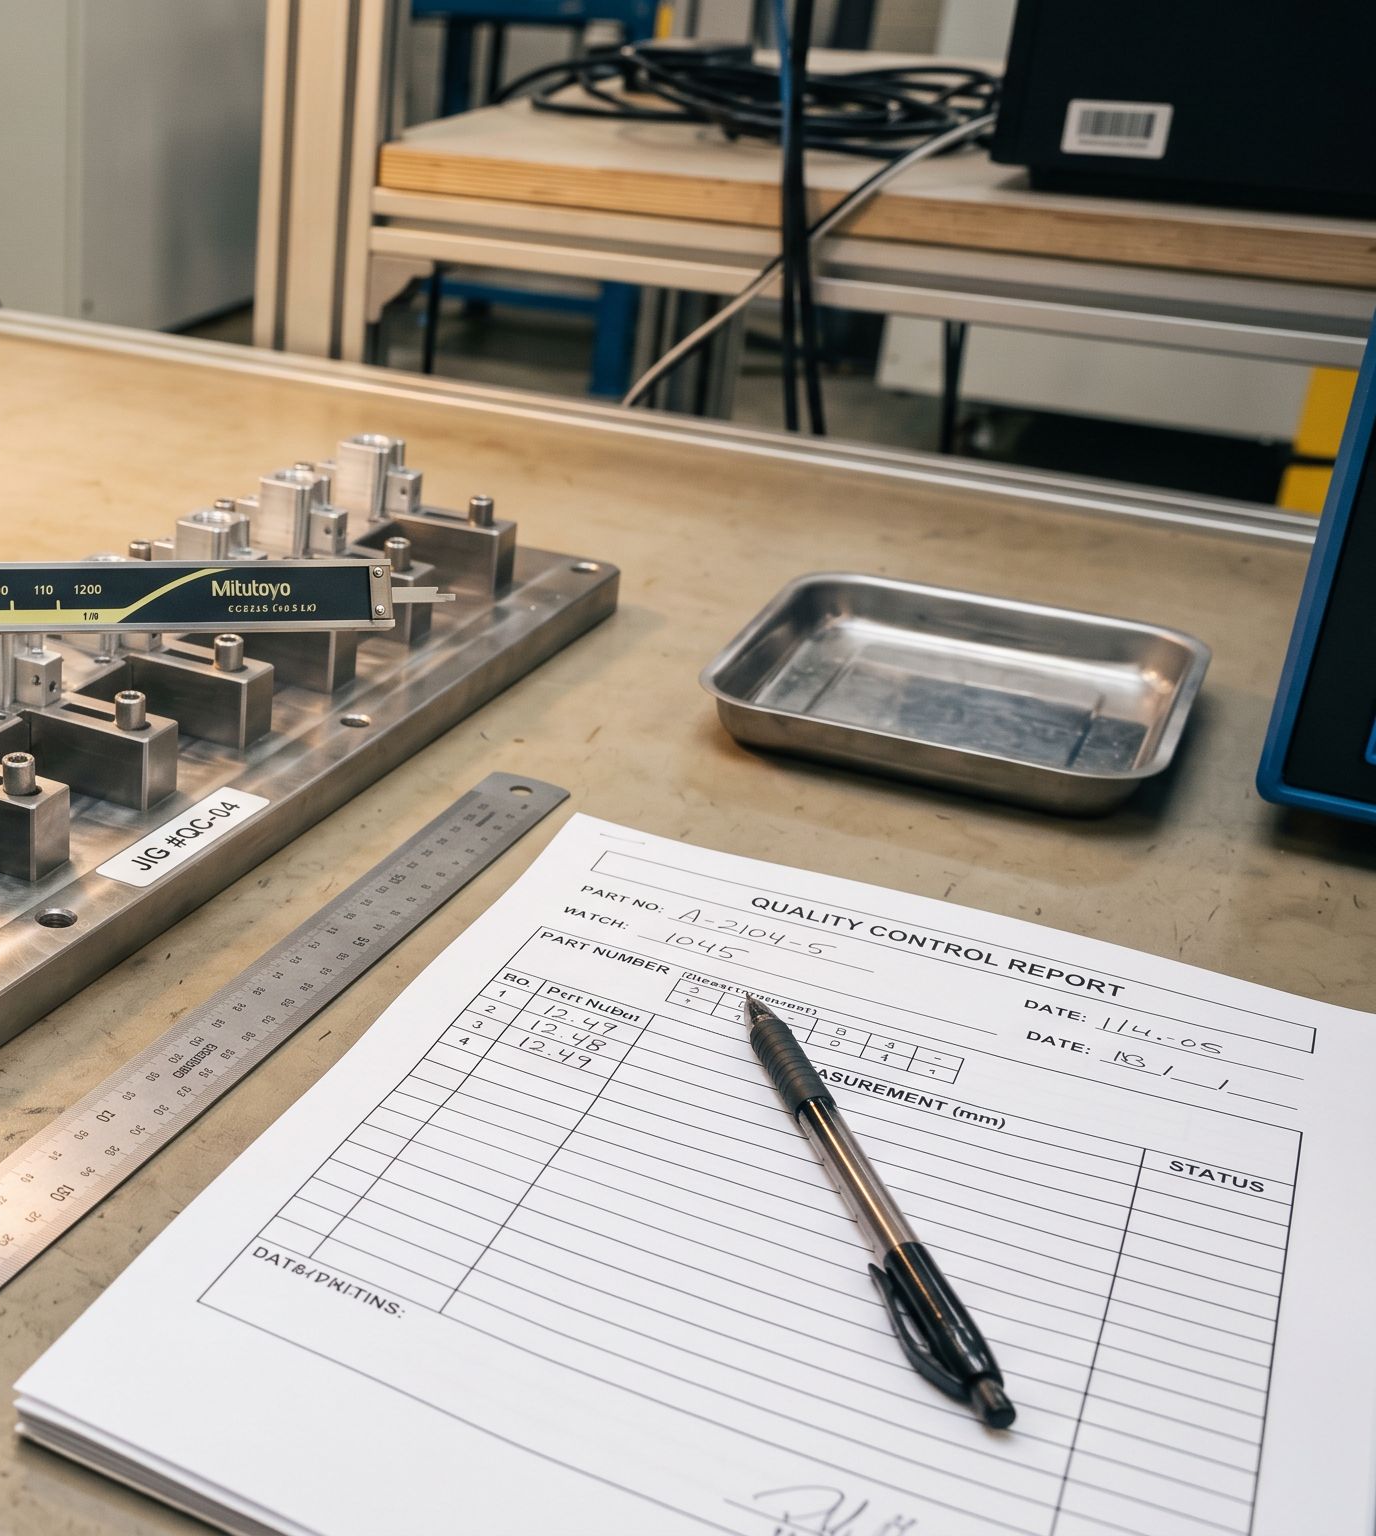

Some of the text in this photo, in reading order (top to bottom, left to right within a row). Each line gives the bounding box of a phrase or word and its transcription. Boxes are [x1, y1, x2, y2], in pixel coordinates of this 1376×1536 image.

[34, 584, 54, 596] 110
[74, 584, 102, 596] 1200
[211, 580, 291, 601] Mitutoyo
[131, 801, 240, 871] JIG #QC-04
[580, 885, 665, 914] PART NO:
[539, 931, 671, 975] PART NUMBER
[664, 932, 750, 959] 1045
[751, 896, 1126, 998] QUALITY CONTROL REPORT
[499, 990, 507, 998] 1
[484, 1005, 496, 1014] 2
[543, 1005, 618, 1035] 12.49
[1024, 999, 1087, 1023] DATE:
[472, 1020, 483, 1029] 3
[530, 1019, 607, 1051] 12.48
[458, 1037, 470, 1046] 4
[519, 1036, 592, 1069] 12.49
[1026, 1030, 1091, 1054] DATE:
[952, 1106, 1006, 1130] (mm)
[1168, 1159, 1265, 1194] STATUS
